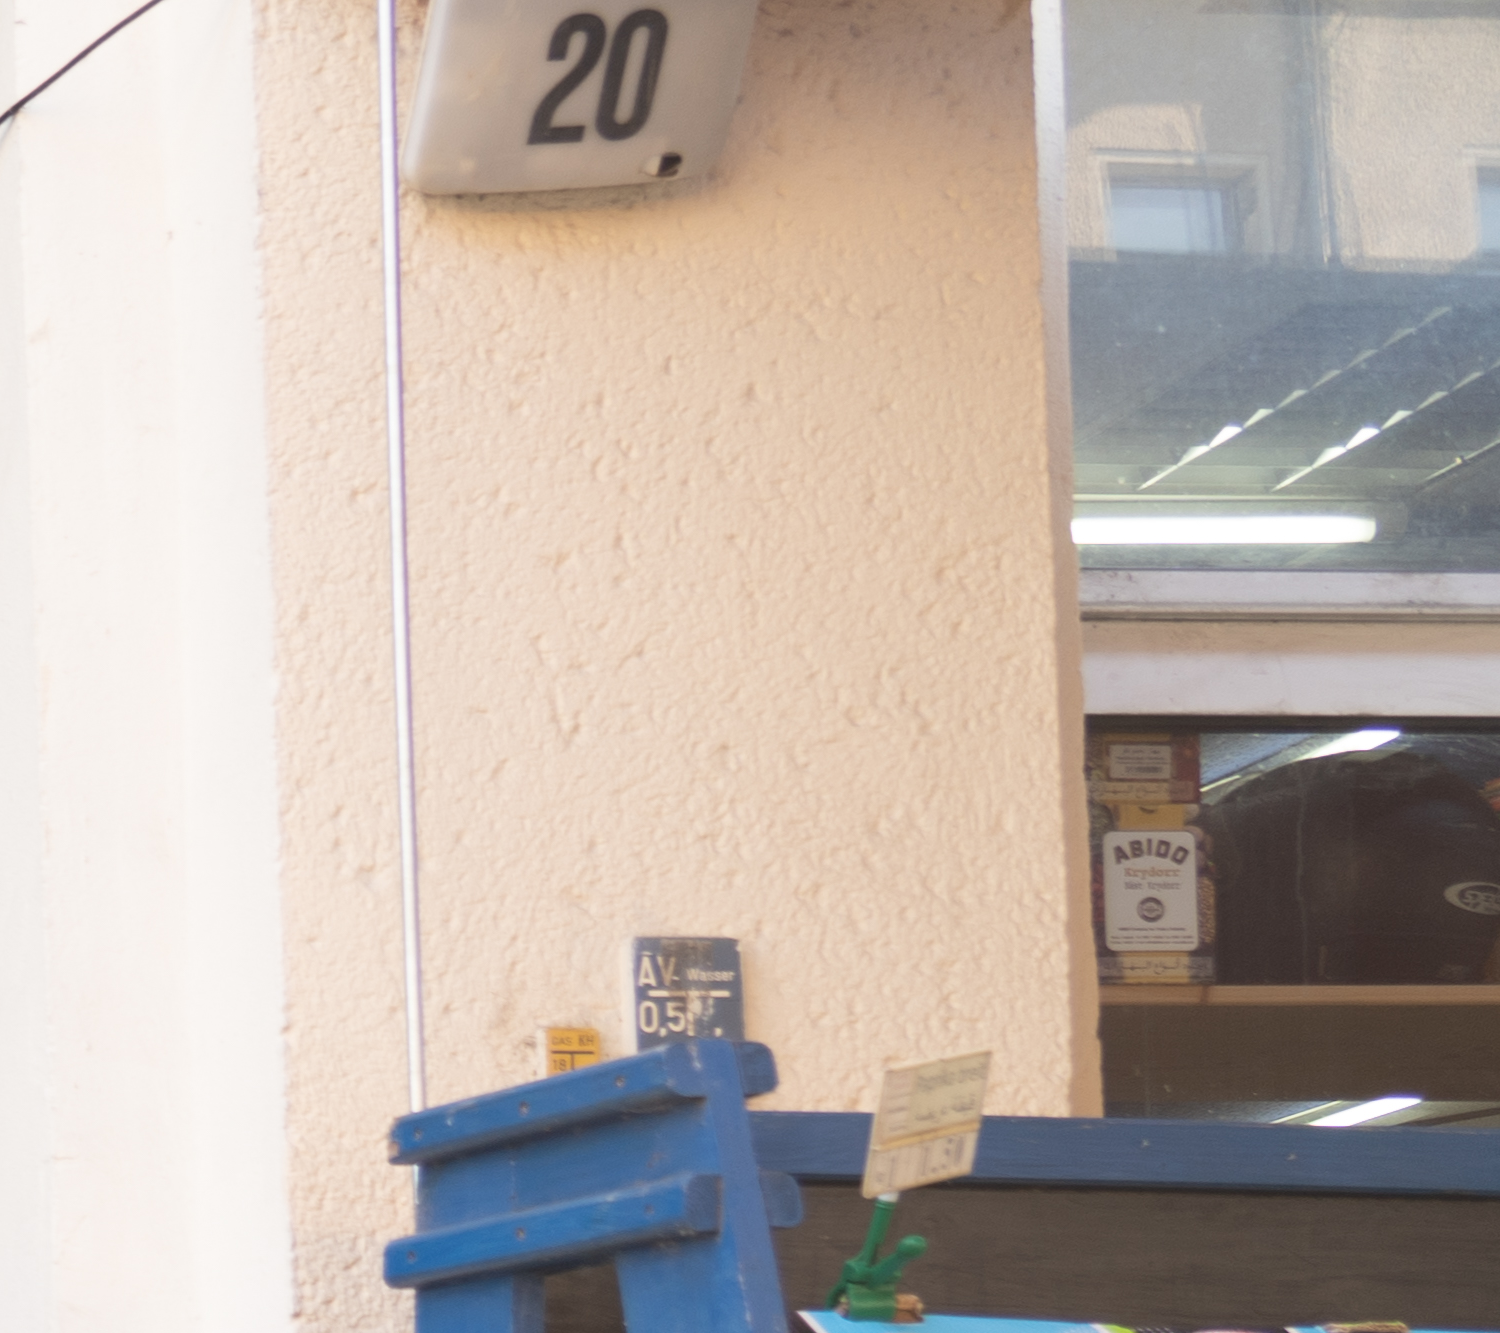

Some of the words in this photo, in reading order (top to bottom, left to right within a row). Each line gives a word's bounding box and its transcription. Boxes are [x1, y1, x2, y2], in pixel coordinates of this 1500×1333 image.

[526, 9, 669, 145] 20
[1113, 838, 1190, 866] ABIDO
[686, 967, 735, 982] Wasser
